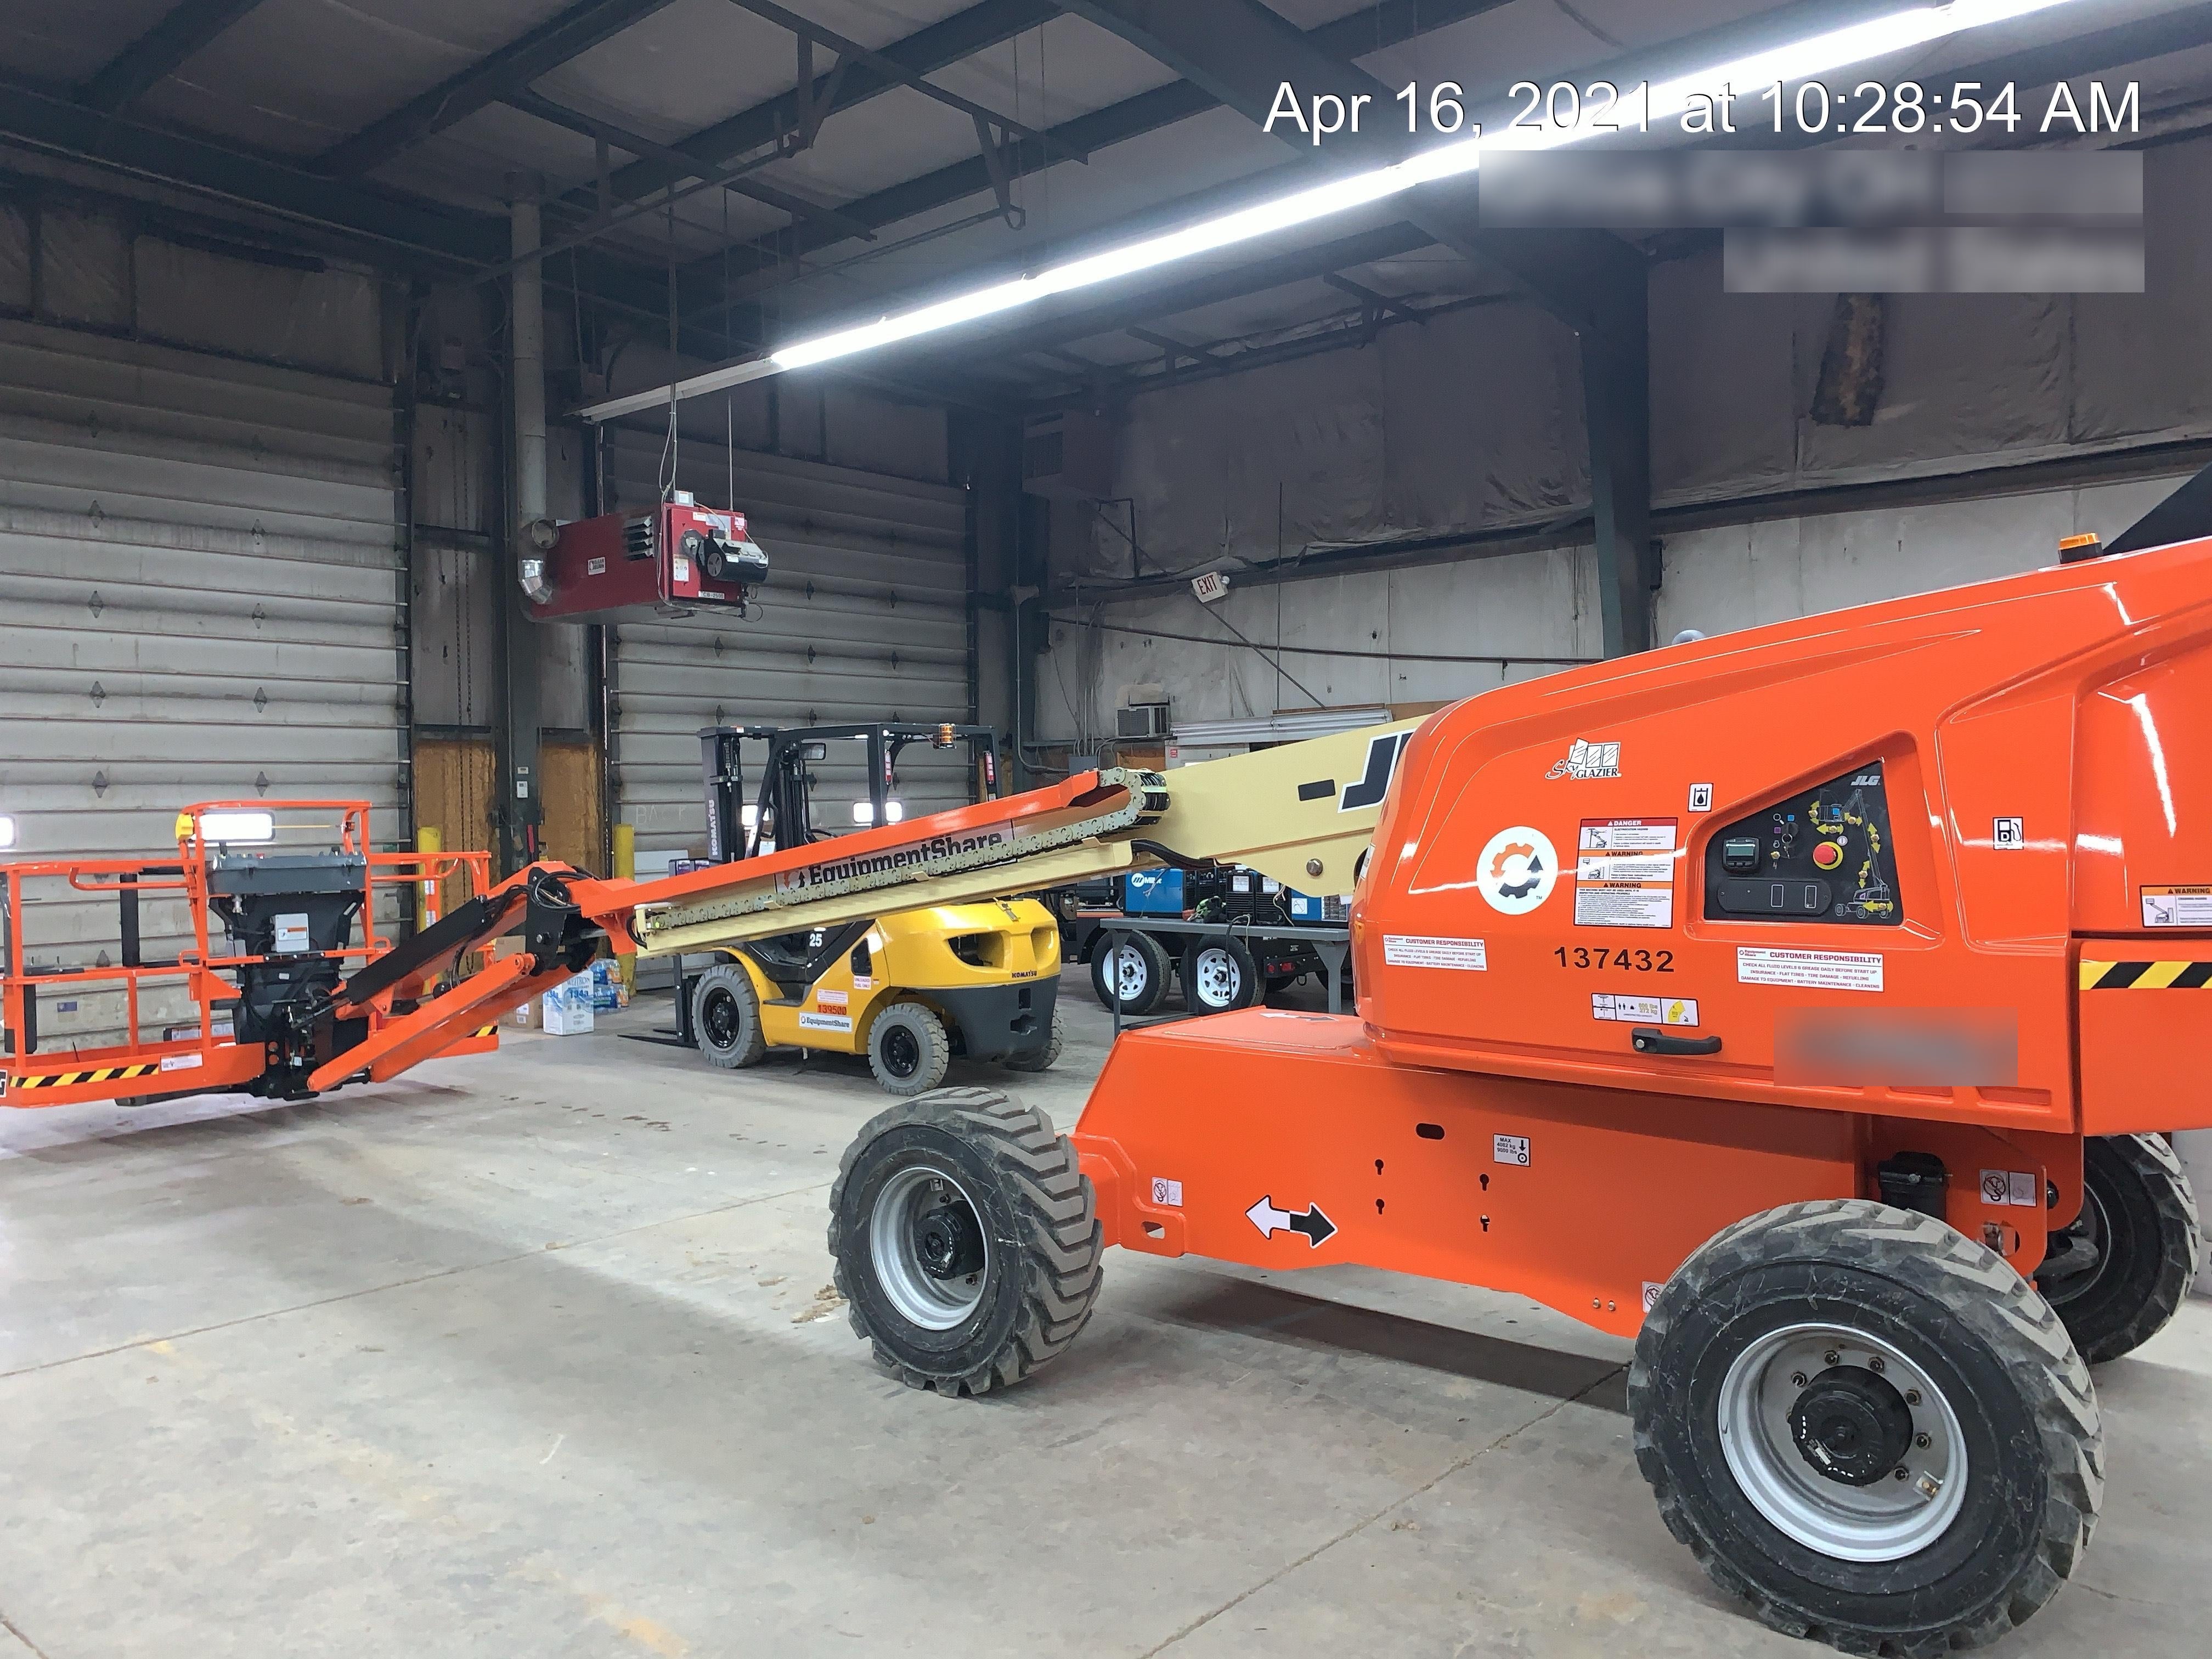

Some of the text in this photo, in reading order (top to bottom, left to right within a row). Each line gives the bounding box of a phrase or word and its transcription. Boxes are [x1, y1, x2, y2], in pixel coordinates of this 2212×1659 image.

[1197, 574, 1217, 595] EXIT
[1576, 768, 1618, 778] GLAZIER
[1850, 775, 1881, 786] JLG
[708, 799, 718, 856] KOMATSU
[809, 933, 822, 947] 25
[1554, 946, 1674, 973] 137432
[1769, 951, 1882, 964] CUSTOMER RESPONSIBILITY
[1012, 970, 1037, 978] KOMATSU
[817, 1005, 847, 1015] 139500
[806, 1018, 850, 1028] EquipmentShare
